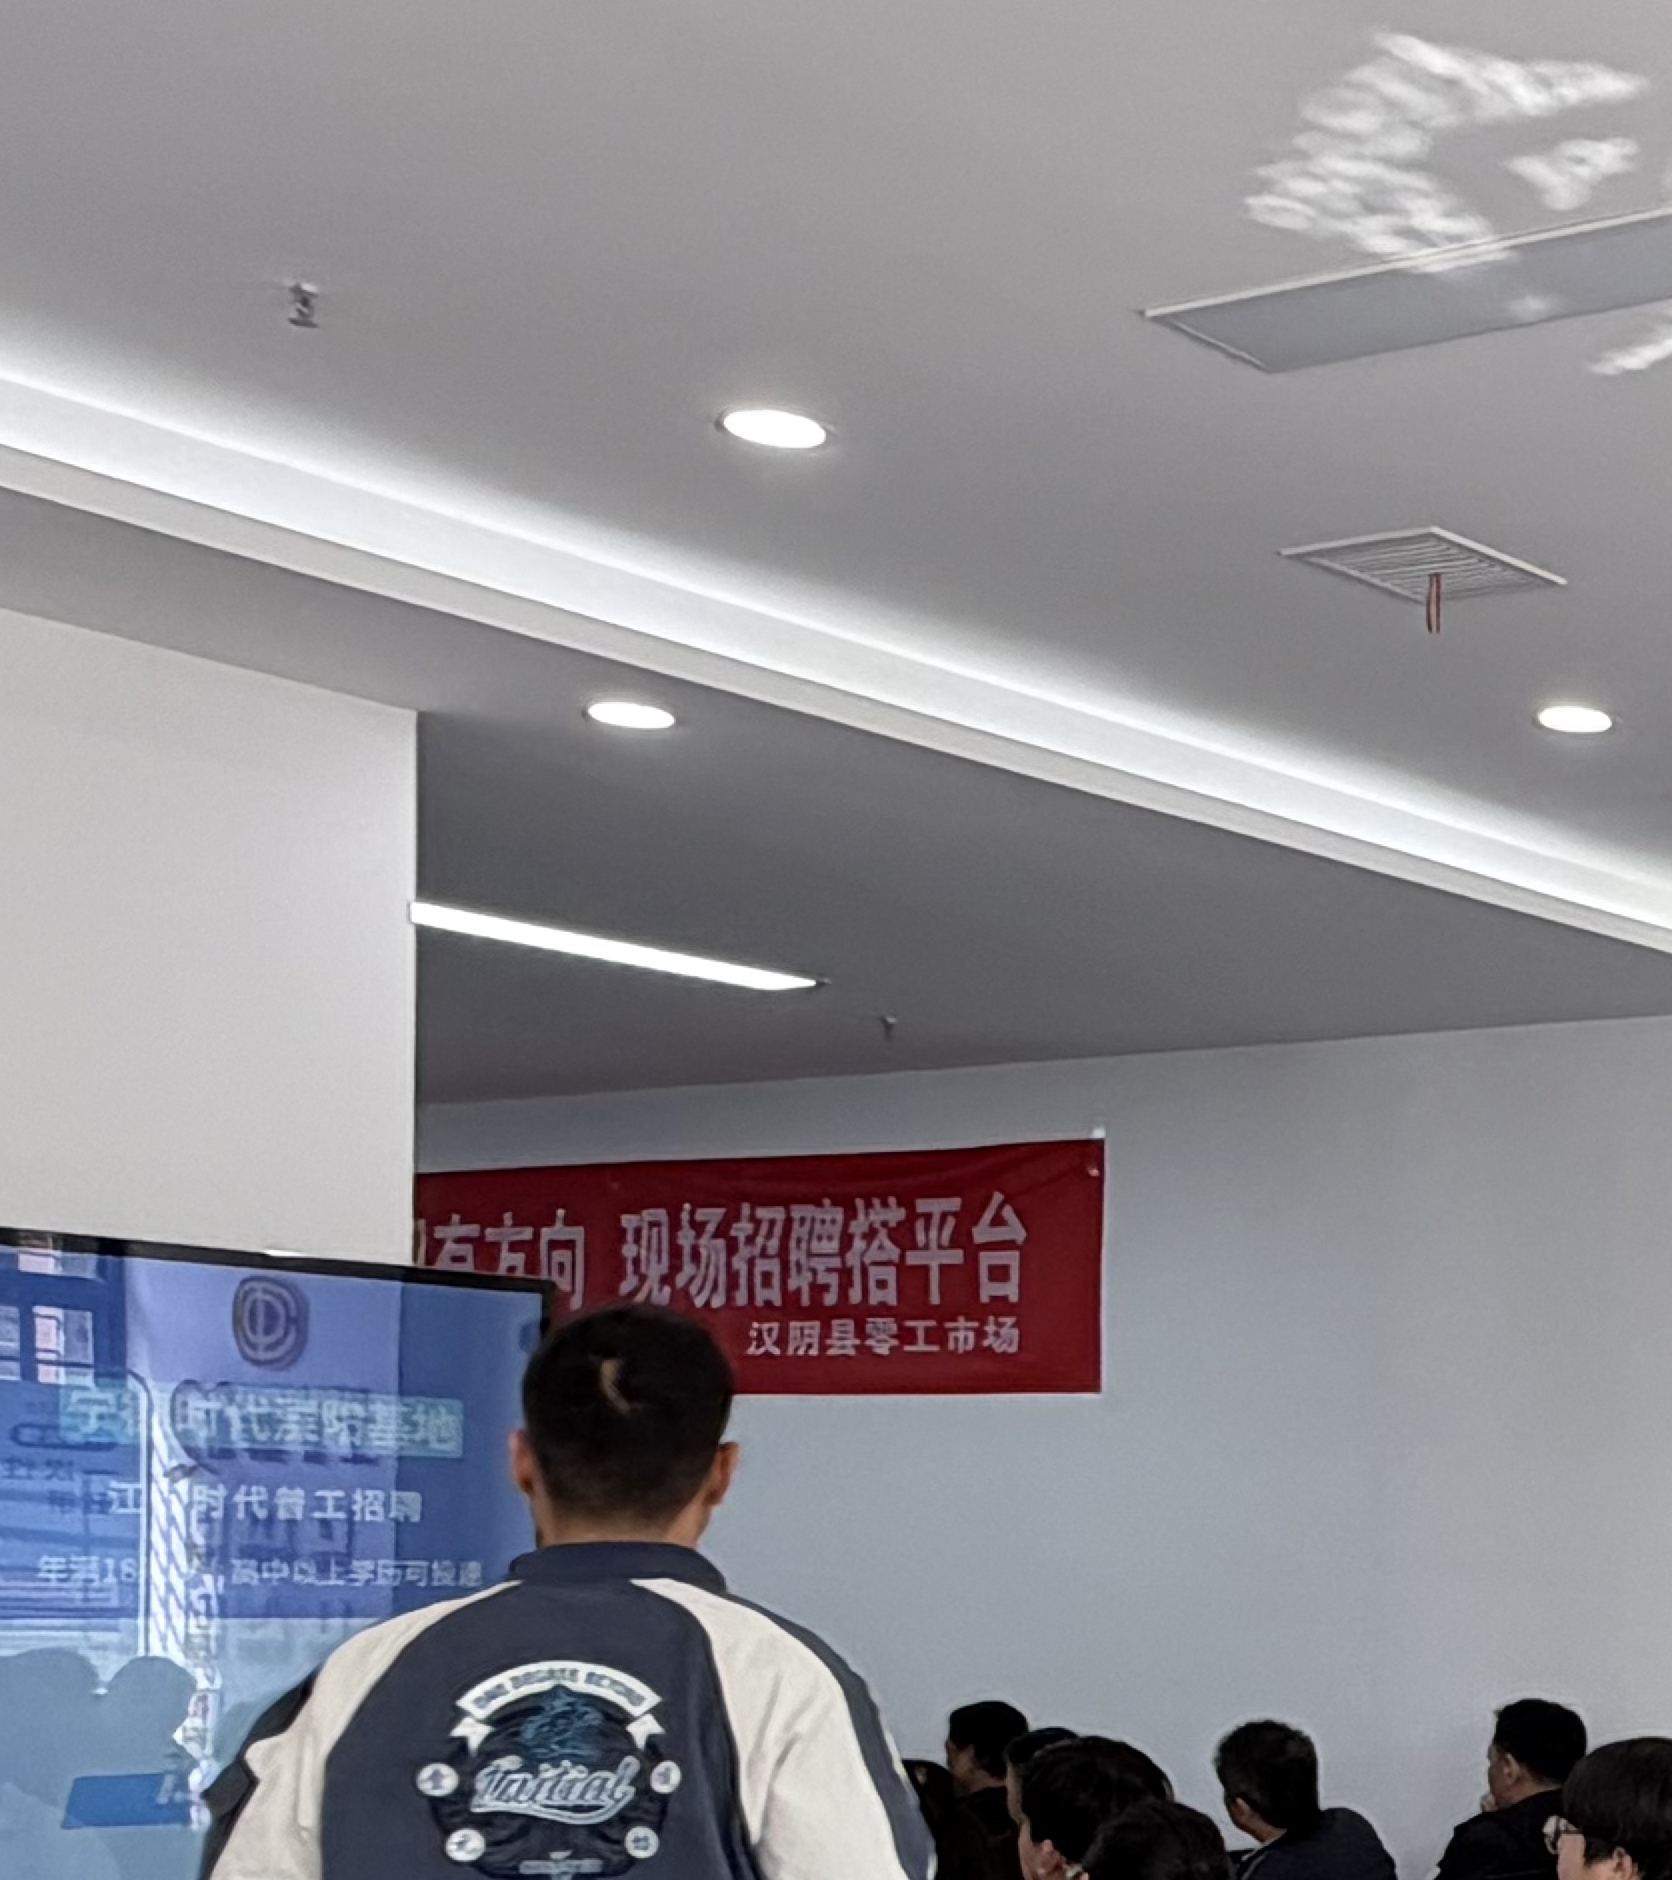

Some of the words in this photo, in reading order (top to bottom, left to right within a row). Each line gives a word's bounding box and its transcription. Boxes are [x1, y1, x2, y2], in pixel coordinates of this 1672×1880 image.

[416, 1208, 585, 1309] 有方向
[618, 1193, 1027, 1308] 现场招聘搭平台
[746, 1316, 1020, 1357] 汉阴县零工市场
[108, 1485, 424, 1522] 江时代普工招聘
